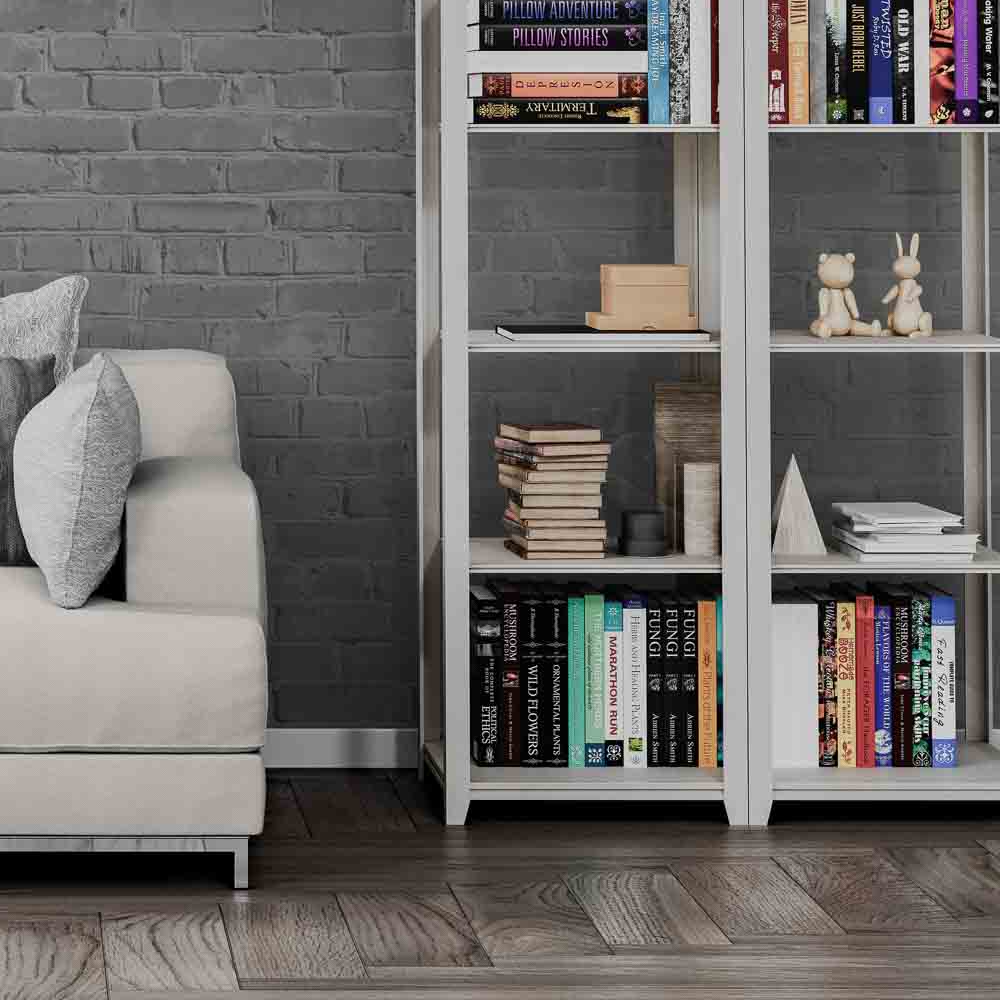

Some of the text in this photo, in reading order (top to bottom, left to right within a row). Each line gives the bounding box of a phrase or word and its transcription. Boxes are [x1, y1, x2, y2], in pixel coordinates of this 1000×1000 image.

[503, 1, 546, 18] PILLOW
[549, 1, 618, 18] ADVENTURE
[851, 4, 865, 23] JUST
[871, 16, 881, 34] Ruby
[880, 0, 892, 59] TWISTED
[513, 28, 556, 47] PILLOW
[560, 28, 609, 46] STORIES
[659, 41, 668, 67] Smith
[851, 26, 865, 47] BORN
[897, 8, 910, 73] OLD WAR
[984, 27, 993, 54] Water
[851, 50, 865, 72] REBEL
[515, 80, 616, 89] DEPRESION
[526, 102, 598, 116] TERMITARY
[509, 603, 518, 661] MUSHROOM
[648, 608, 661, 658] FUNGI
[665, 608, 679, 658] FUNGI
[683, 608, 696, 658] FUNGI
[823, 601, 837, 643] Whiskey
[900, 607, 909, 664] MUSHROOM
[608, 635, 618, 736] MARATHON RUN
[882, 620, 891, 729] FLAVORS OF THE WORLD
[933, 638, 949, 727] Fast Reading
[481, 705, 491, 745] ETHICS
[490, 705, 498, 744] POLITICAL
[527, 664, 539, 756] WILD FLOWERS
[552, 664, 561, 756] ORNAMENTAL PLANTS
[631, 703, 641, 735] PLANTS
[913, 716, 923, 744] skills
